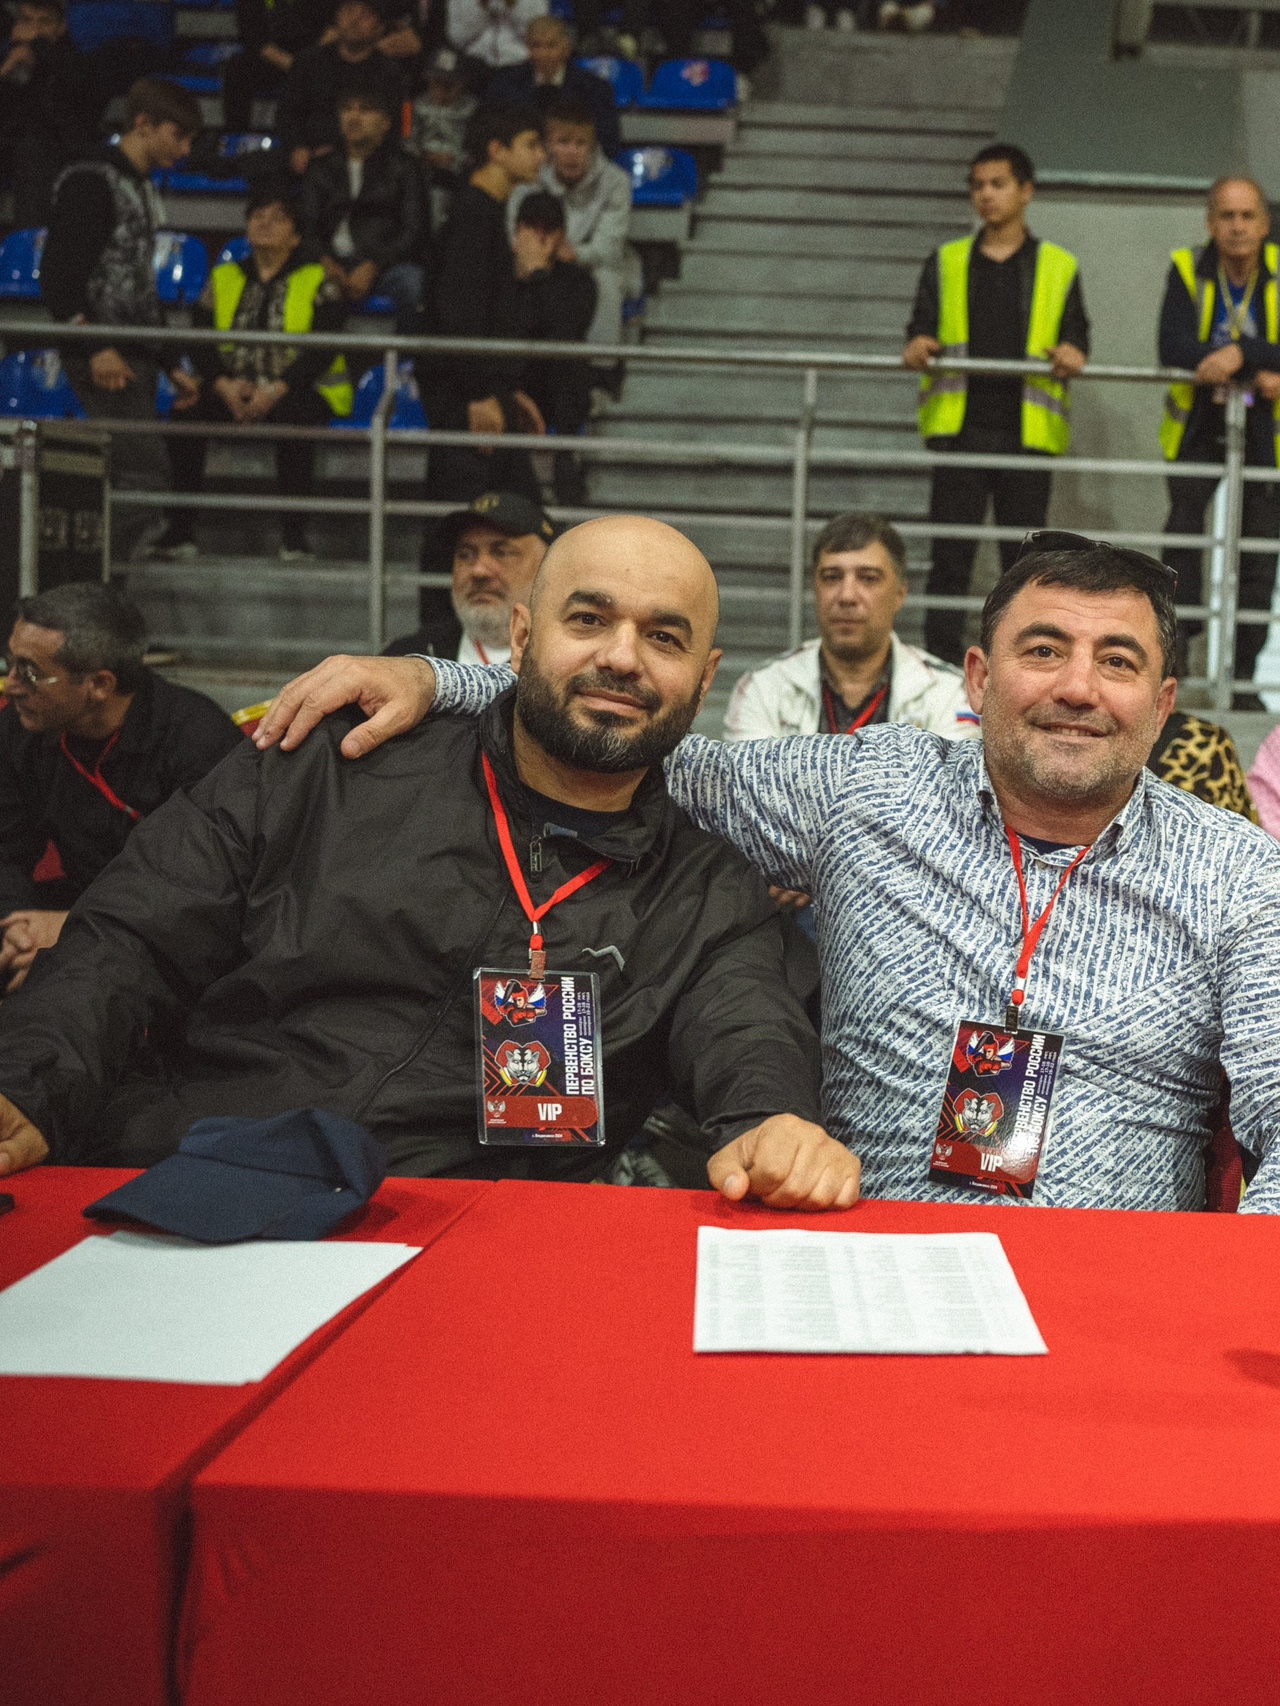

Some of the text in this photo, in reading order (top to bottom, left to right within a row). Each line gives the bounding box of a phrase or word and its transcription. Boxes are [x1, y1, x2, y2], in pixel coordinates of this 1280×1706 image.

[560, 976, 580, 1095] ПЕРВЕНСТВО РОССИИ
[579, 1037, 595, 1095] ПО БОКСУ
[537, 1103, 563, 1121] VIP
[1009, 1034, 1046, 1147] РВЕНСТВО РОССИИ
[1029, 1095, 1048, 1134] БОКСУ
[980, 1152, 1004, 1172] VIP
